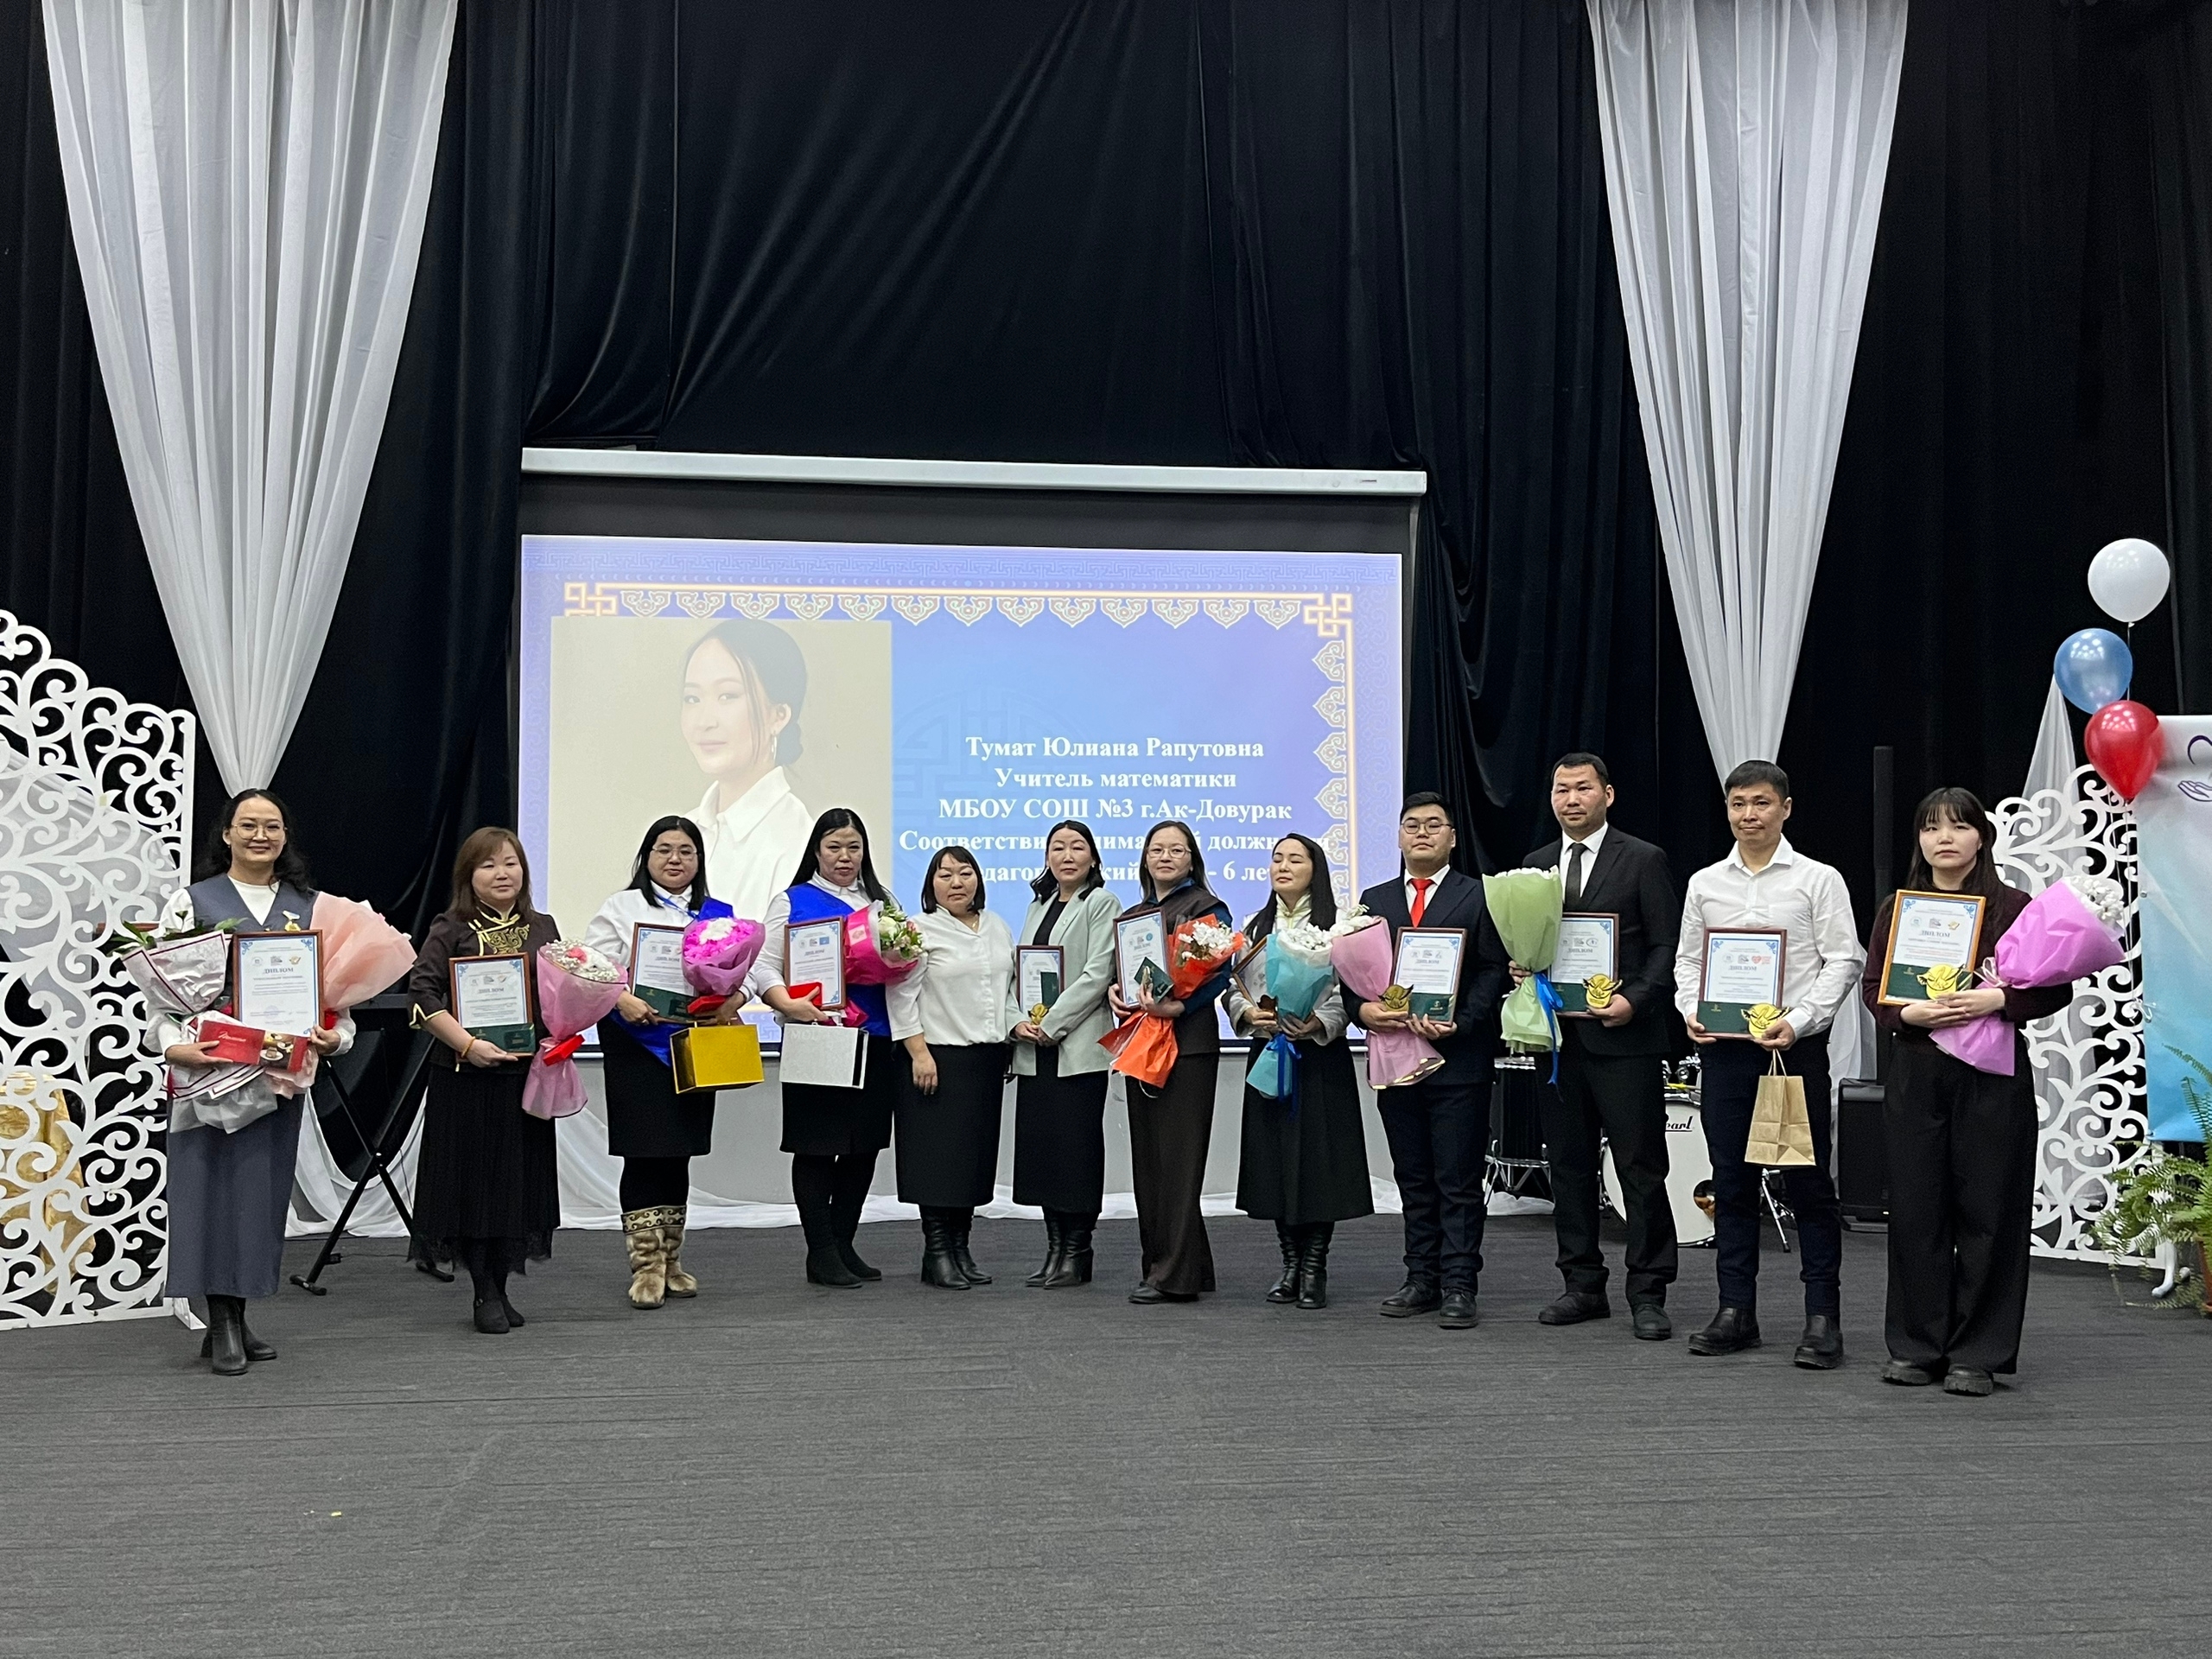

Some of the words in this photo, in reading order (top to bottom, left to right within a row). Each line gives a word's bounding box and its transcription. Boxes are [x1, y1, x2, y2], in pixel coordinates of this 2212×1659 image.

[965, 736, 1036, 761] Тумат
[1042, 736, 1139, 757] Юлиана
[1146, 737, 1264, 762] Рапутовна
[994, 767, 1094, 788] Учитель
[1100, 772, 1236, 788] математики
[938, 798, 1017, 818] МБОУ
[1023, 798, 1089, 818] СОШ
[1096, 798, 1134, 818] №3
[1141, 798, 1293, 823] г.Ак-Довурак
[899, 830, 1046, 850] Соответстви
[1223, 861, 1236, 880] 6
[1241, 867, 1270, 880] ле
[1665, 1116, 1694, 1132] earl
